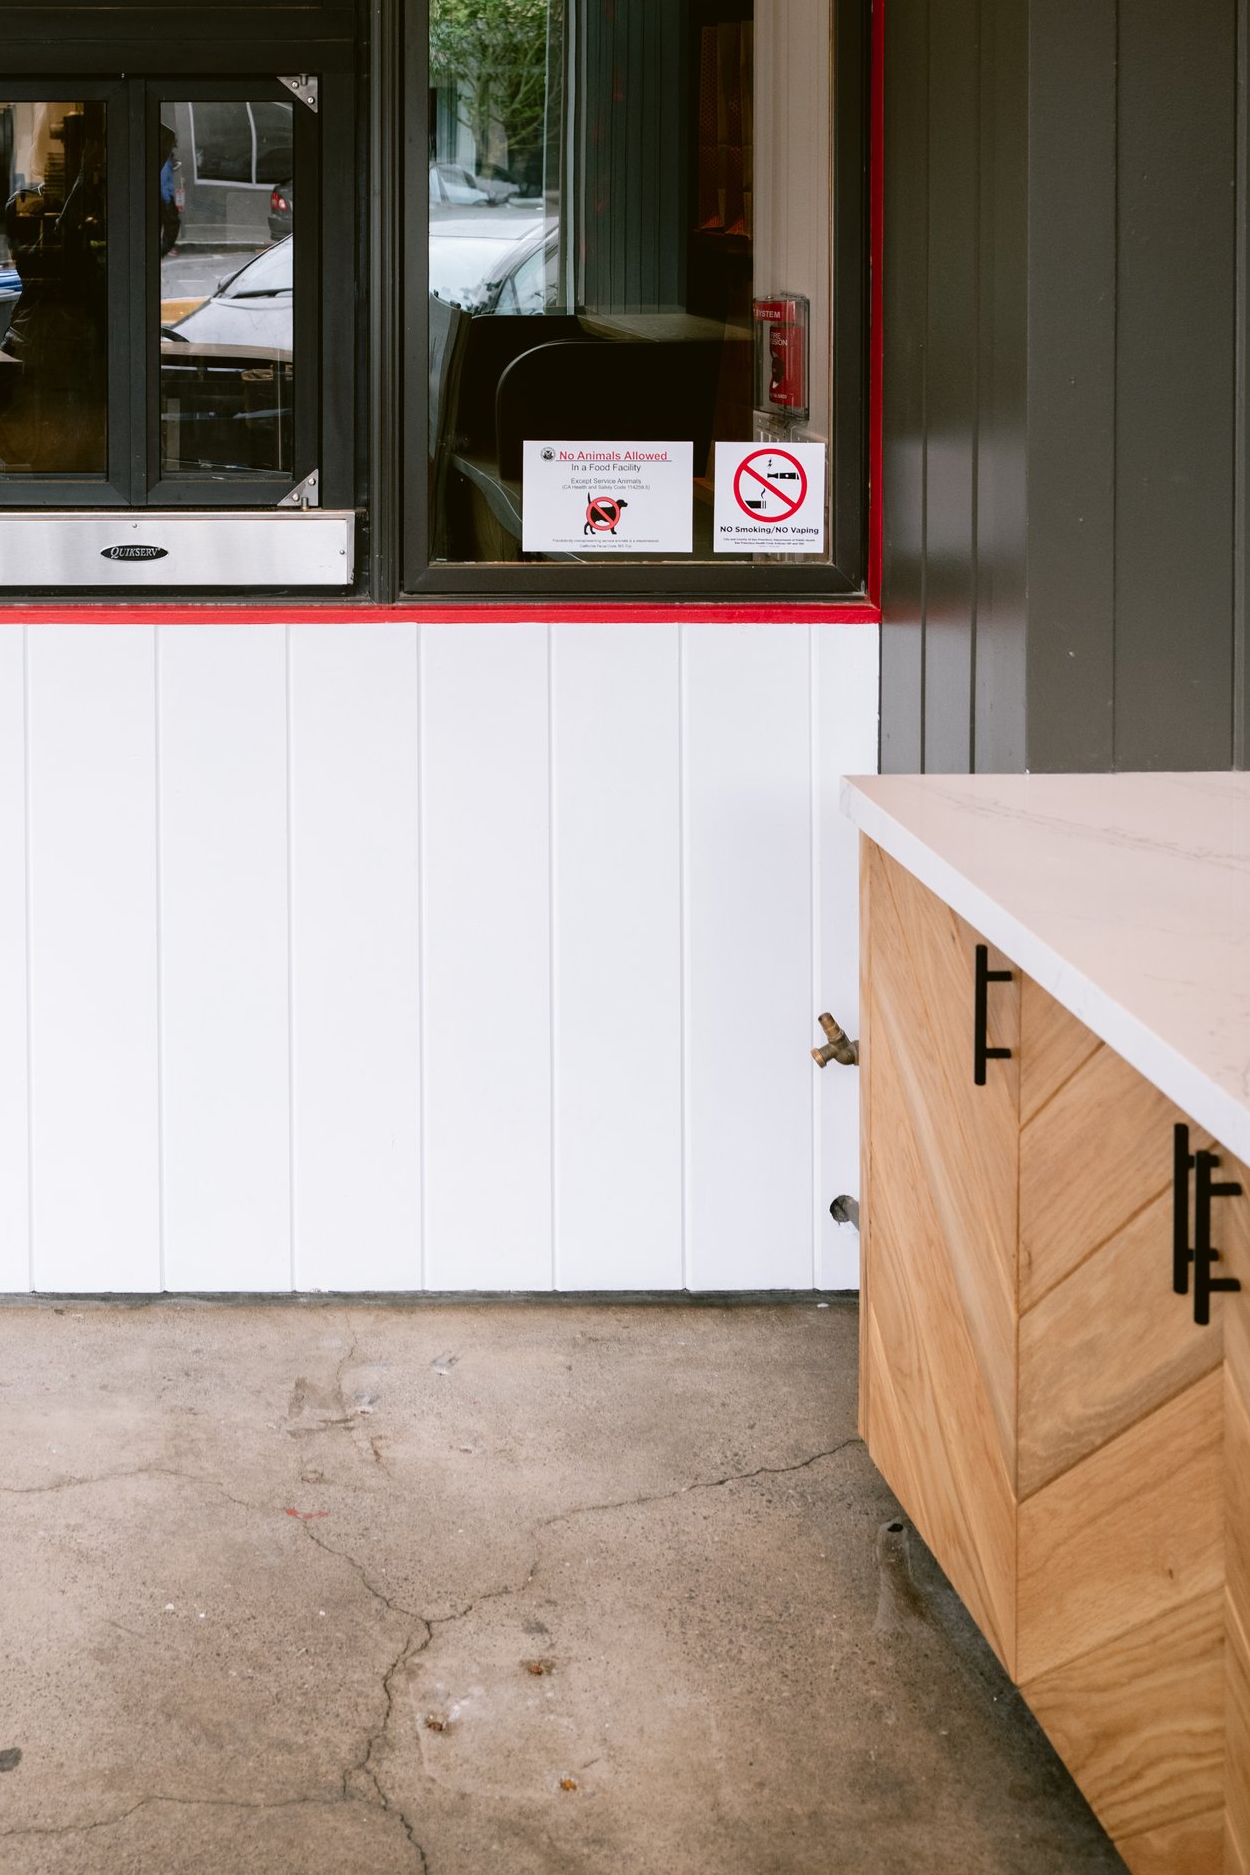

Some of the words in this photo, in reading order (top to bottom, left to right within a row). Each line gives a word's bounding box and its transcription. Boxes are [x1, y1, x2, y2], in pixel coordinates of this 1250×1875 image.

[560, 451, 574, 461] No
[578, 451, 621, 461] Animals
[624, 451, 668, 461] Allowed
[572, 463, 580, 471] In
[589, 463, 610, 471] Food
[612, 463, 642, 473] Facility
[570, 478, 592, 486] Except
[735, 525, 788, 535] Smoking/NO
[791, 527, 820, 535] Vaping
